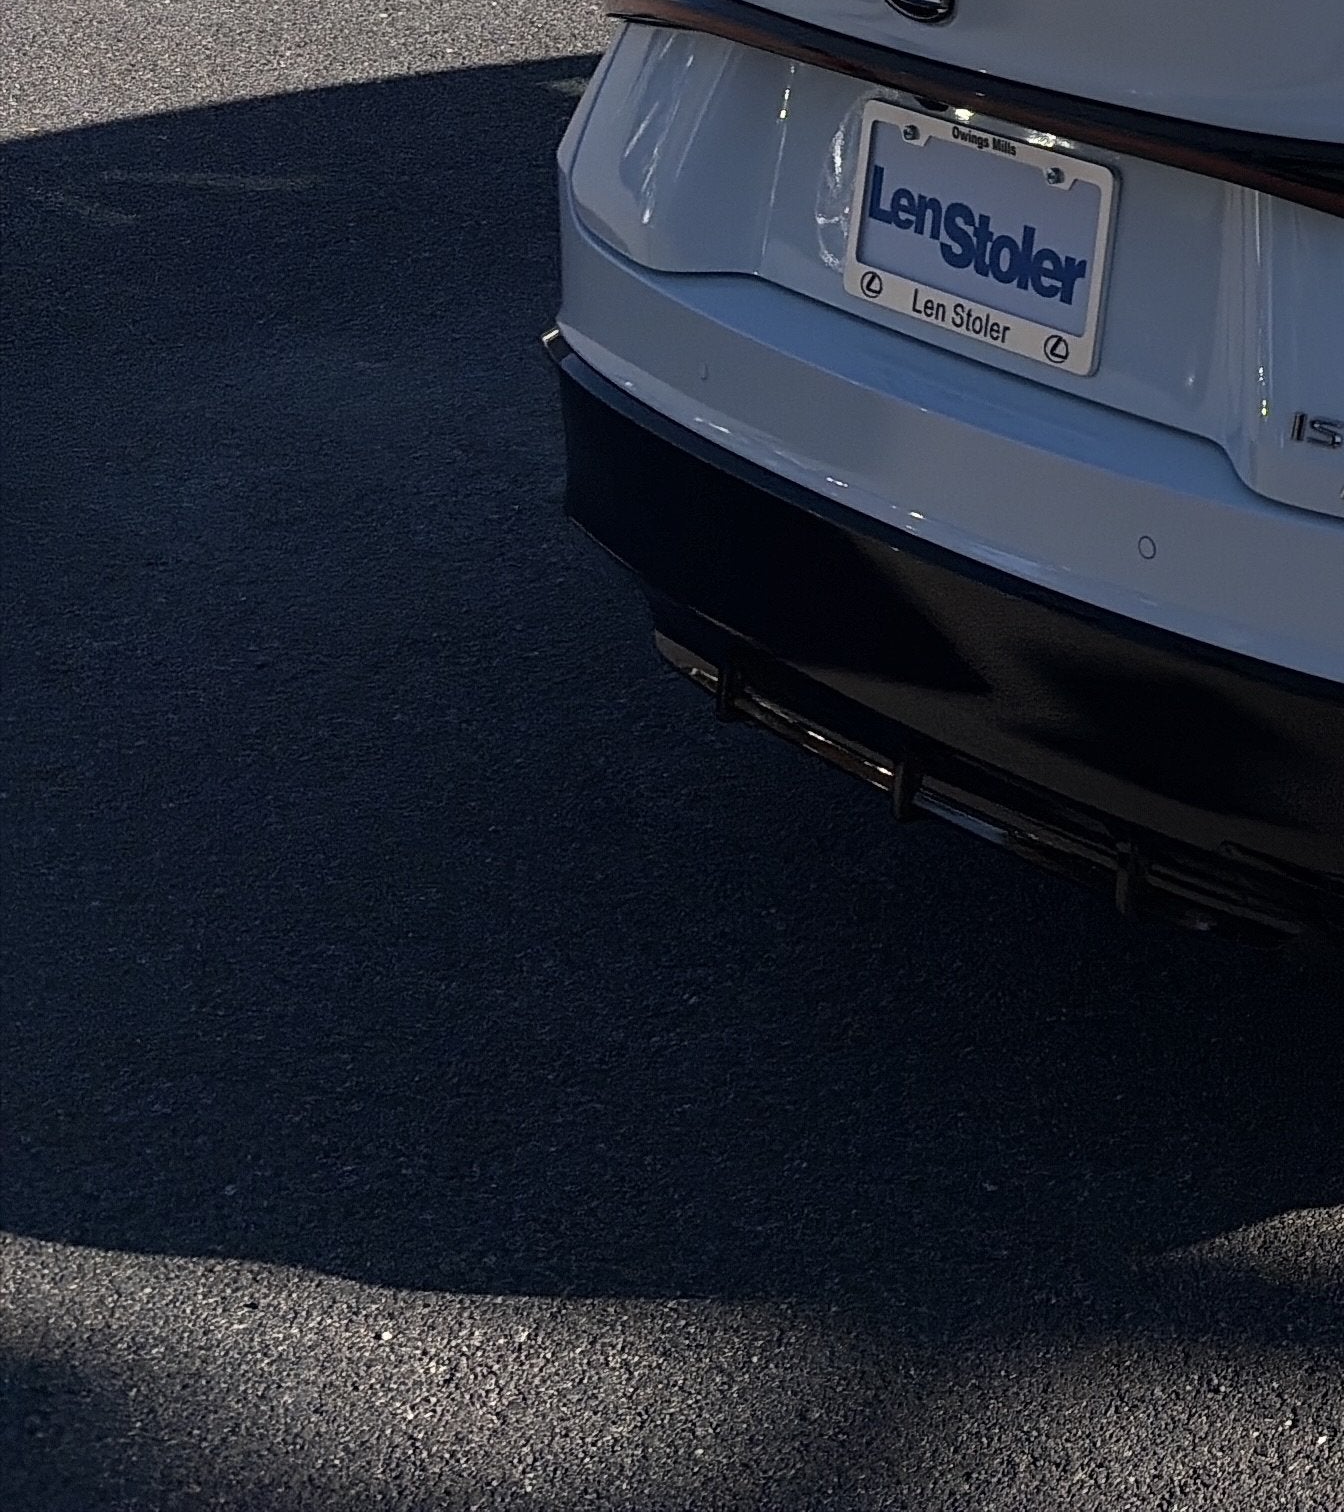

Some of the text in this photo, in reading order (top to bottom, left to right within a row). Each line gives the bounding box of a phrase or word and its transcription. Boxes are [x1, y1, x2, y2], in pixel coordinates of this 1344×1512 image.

[952, 126, 1017, 157] Owings Mills
[911, 288, 1010, 344] Len Stoler
